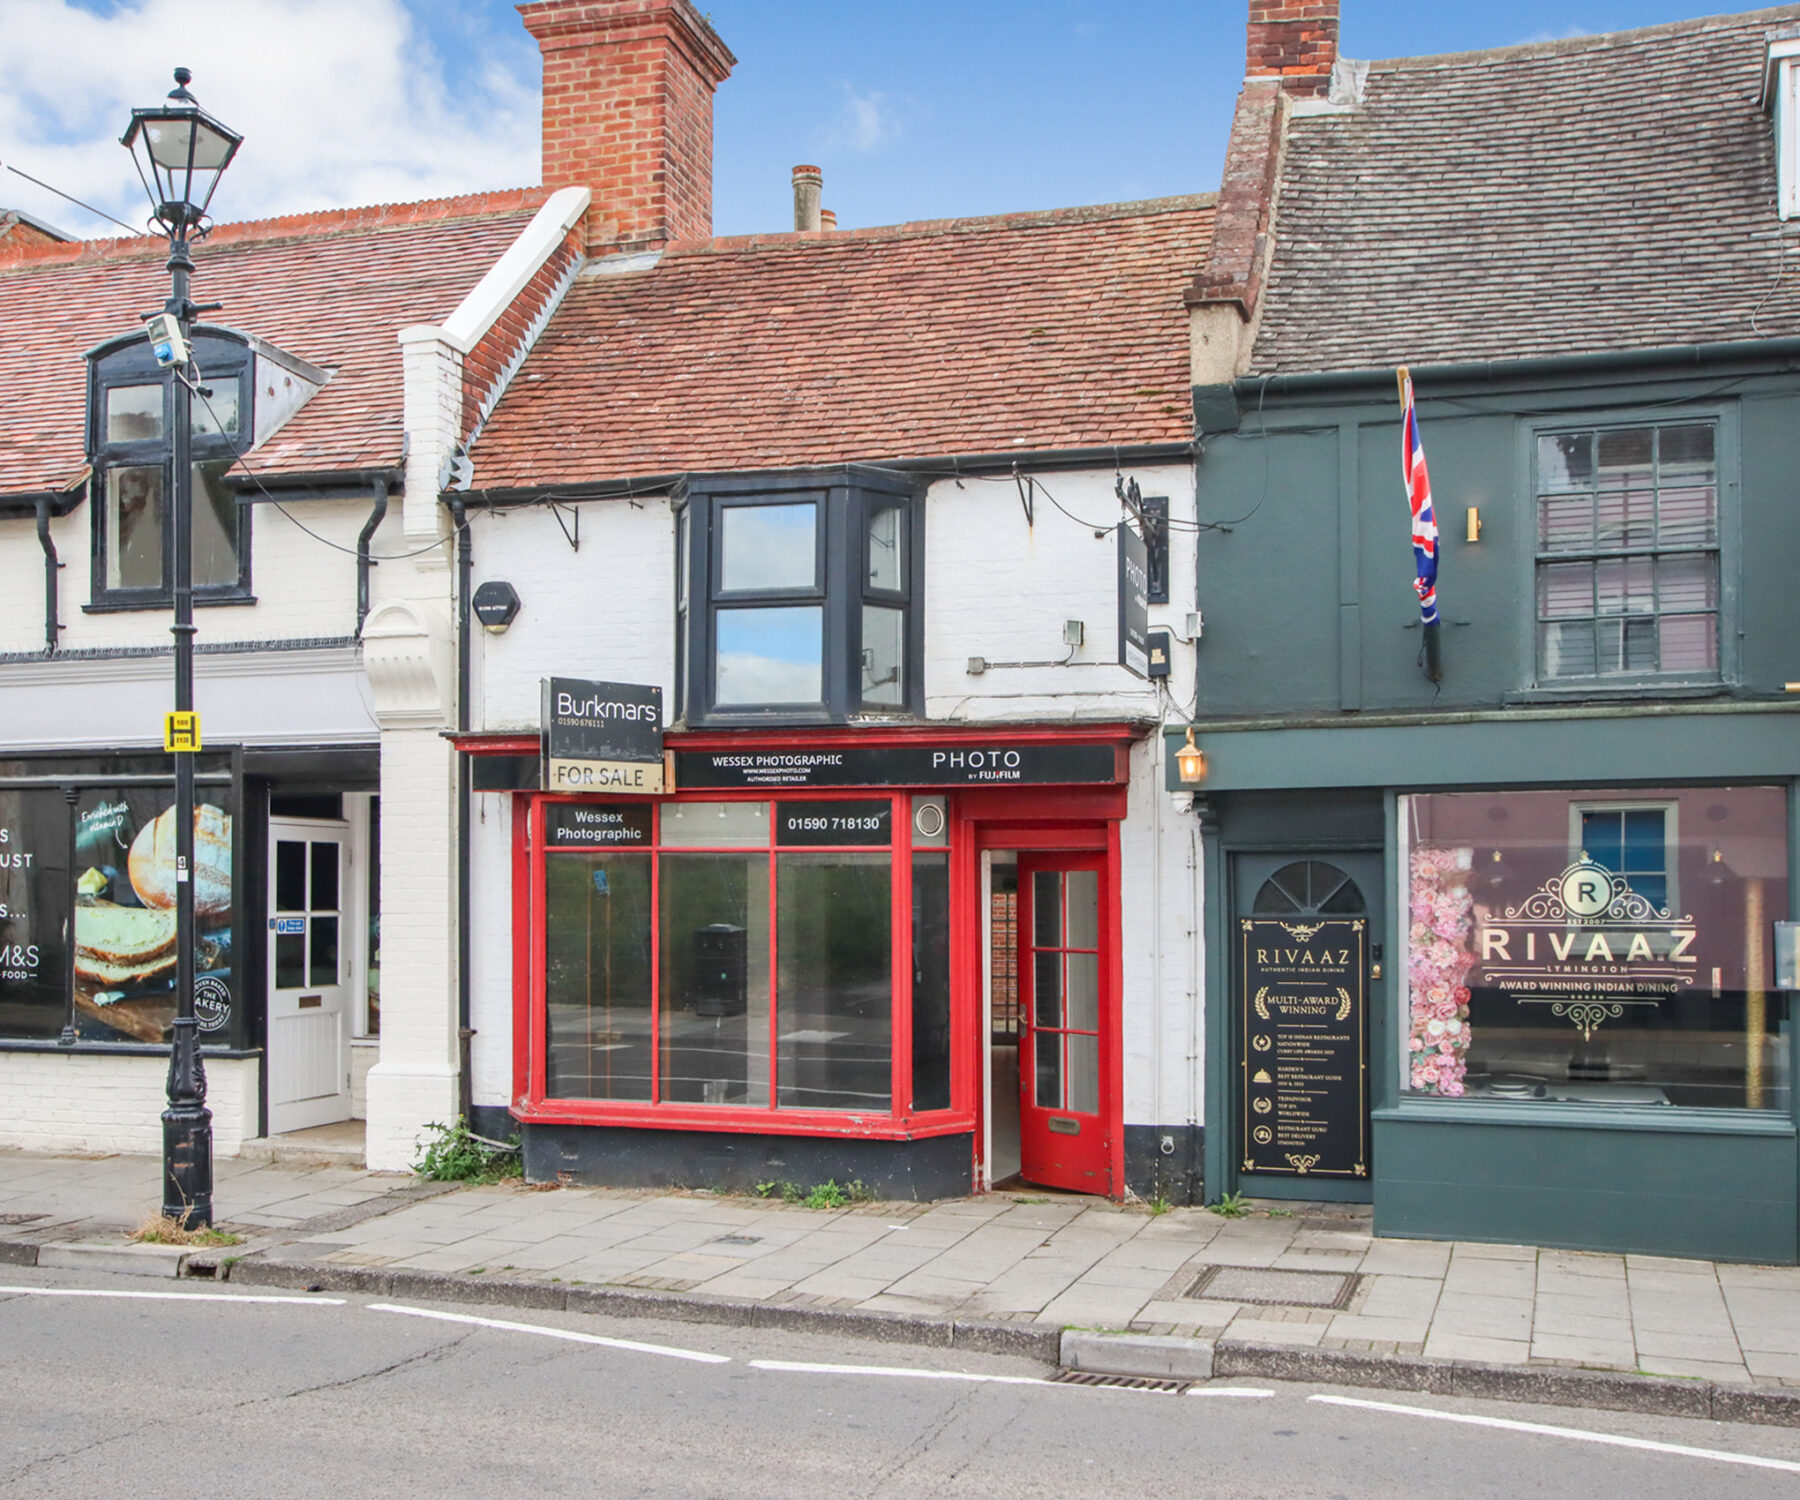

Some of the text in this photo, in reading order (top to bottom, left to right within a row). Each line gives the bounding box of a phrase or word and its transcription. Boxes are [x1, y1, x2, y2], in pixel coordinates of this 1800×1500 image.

[1126, 556, 1147, 595] PHOTO
[558, 693, 656, 721] Burkmars
[558, 718, 604, 728] 01590 676111
[713, 754, 842, 766] WESSEX PHOTOGRAPHIC
[933, 751, 1020, 768] PHOTO
[558, 766, 643, 787] FOR SALE
[980, 770, 1020, 780] FUJIFILM
[81, 800, 129, 823] Enriched with
[575, 811, 623, 823] Wessex
[89, 814, 124, 832] vitamin D
[788, 817, 879, 830] 01590 718130
[557, 826, 641, 841] Photographic
[1577, 882, 1597, 902] R
[1482, 929, 1697, 962] RIVAAZ
[1257, 949, 1349, 964] RIVAAZ
[2, 970, 28, 979] FOOD
[1547, 965, 1629, 974] LYMINGTON
[1500, 981, 1679, 993] AWARD WINNING INDIAN DINING
[203, 990, 217, 1000] THE
[1267, 996, 1339, 1005] MULTI-AWARD
[194, 996, 230, 1014] AKERY
[1279, 1005, 1327, 1015] WINNING
